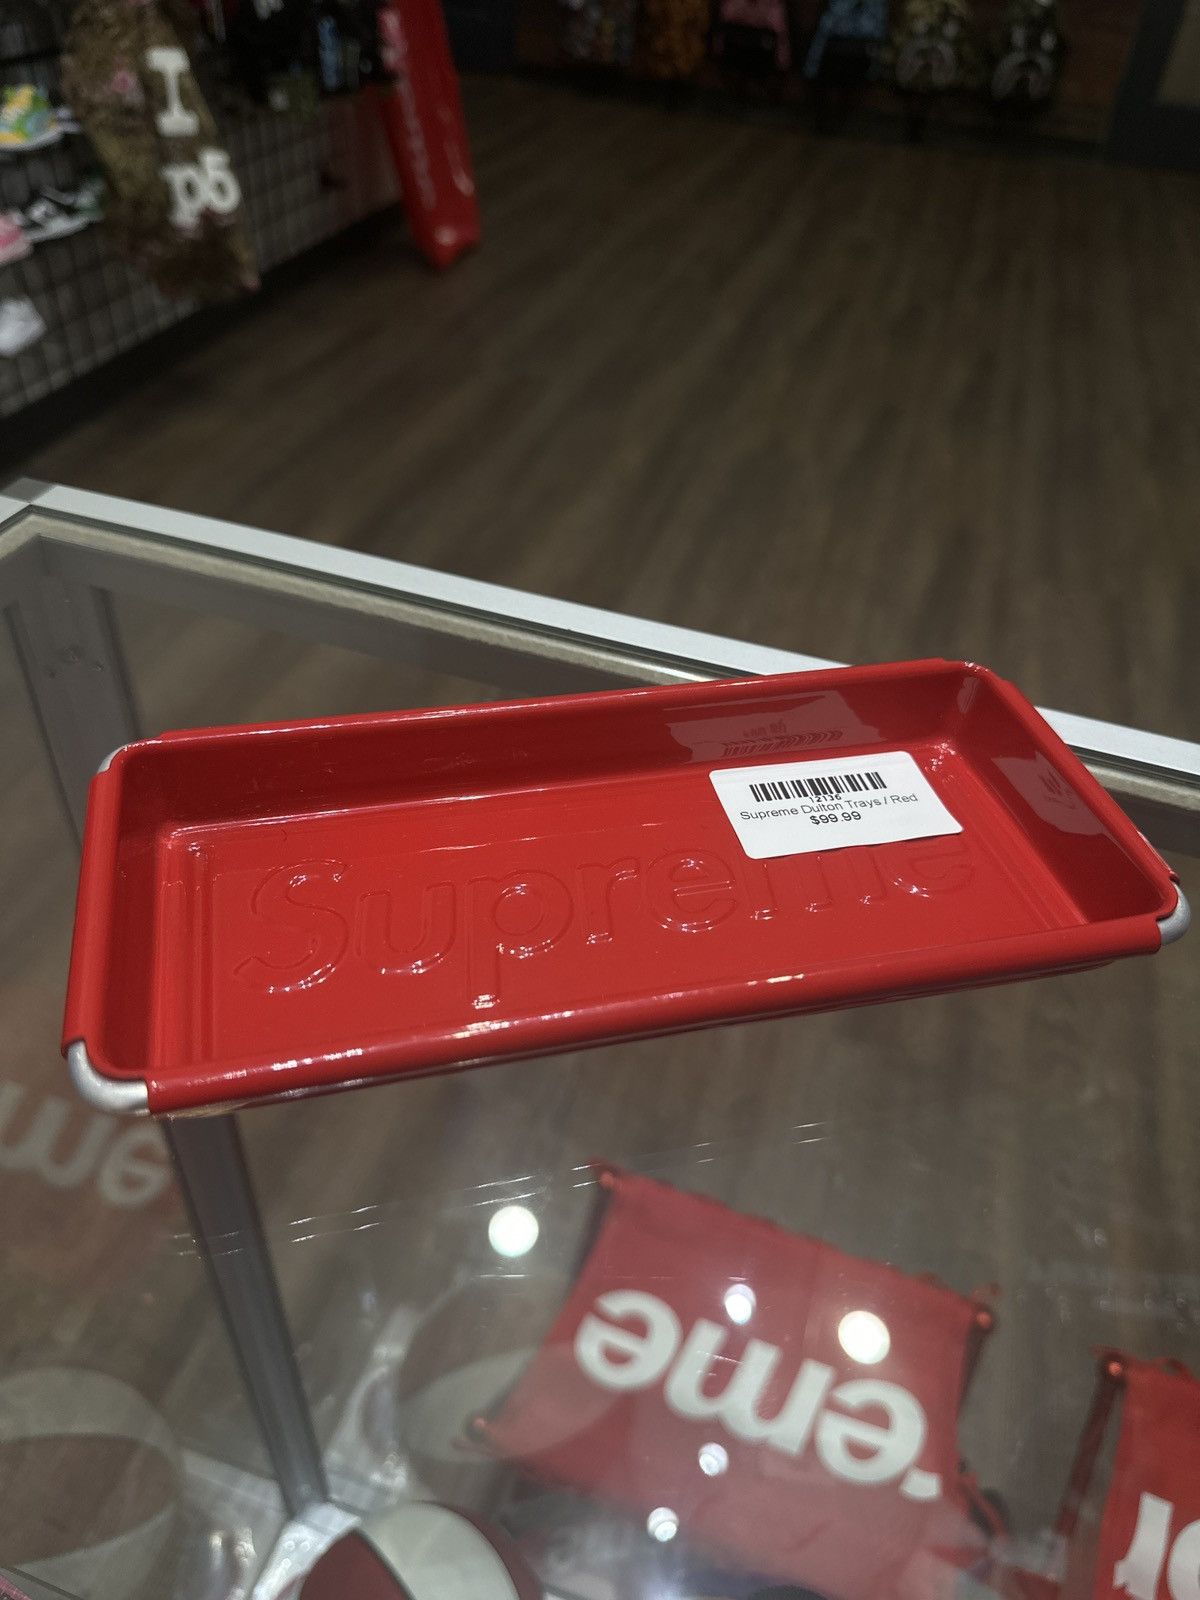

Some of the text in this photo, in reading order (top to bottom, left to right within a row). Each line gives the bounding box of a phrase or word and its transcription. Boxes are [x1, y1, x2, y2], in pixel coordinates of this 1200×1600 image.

[740, 807, 799, 820] Supreme
[800, 802, 844, 814] Dulton
[845, 799, 882, 808] Trays
[890, 793, 919, 804] Red
[810, 811, 861, 825] $99.99
[574, 1288, 942, 1500] eme
